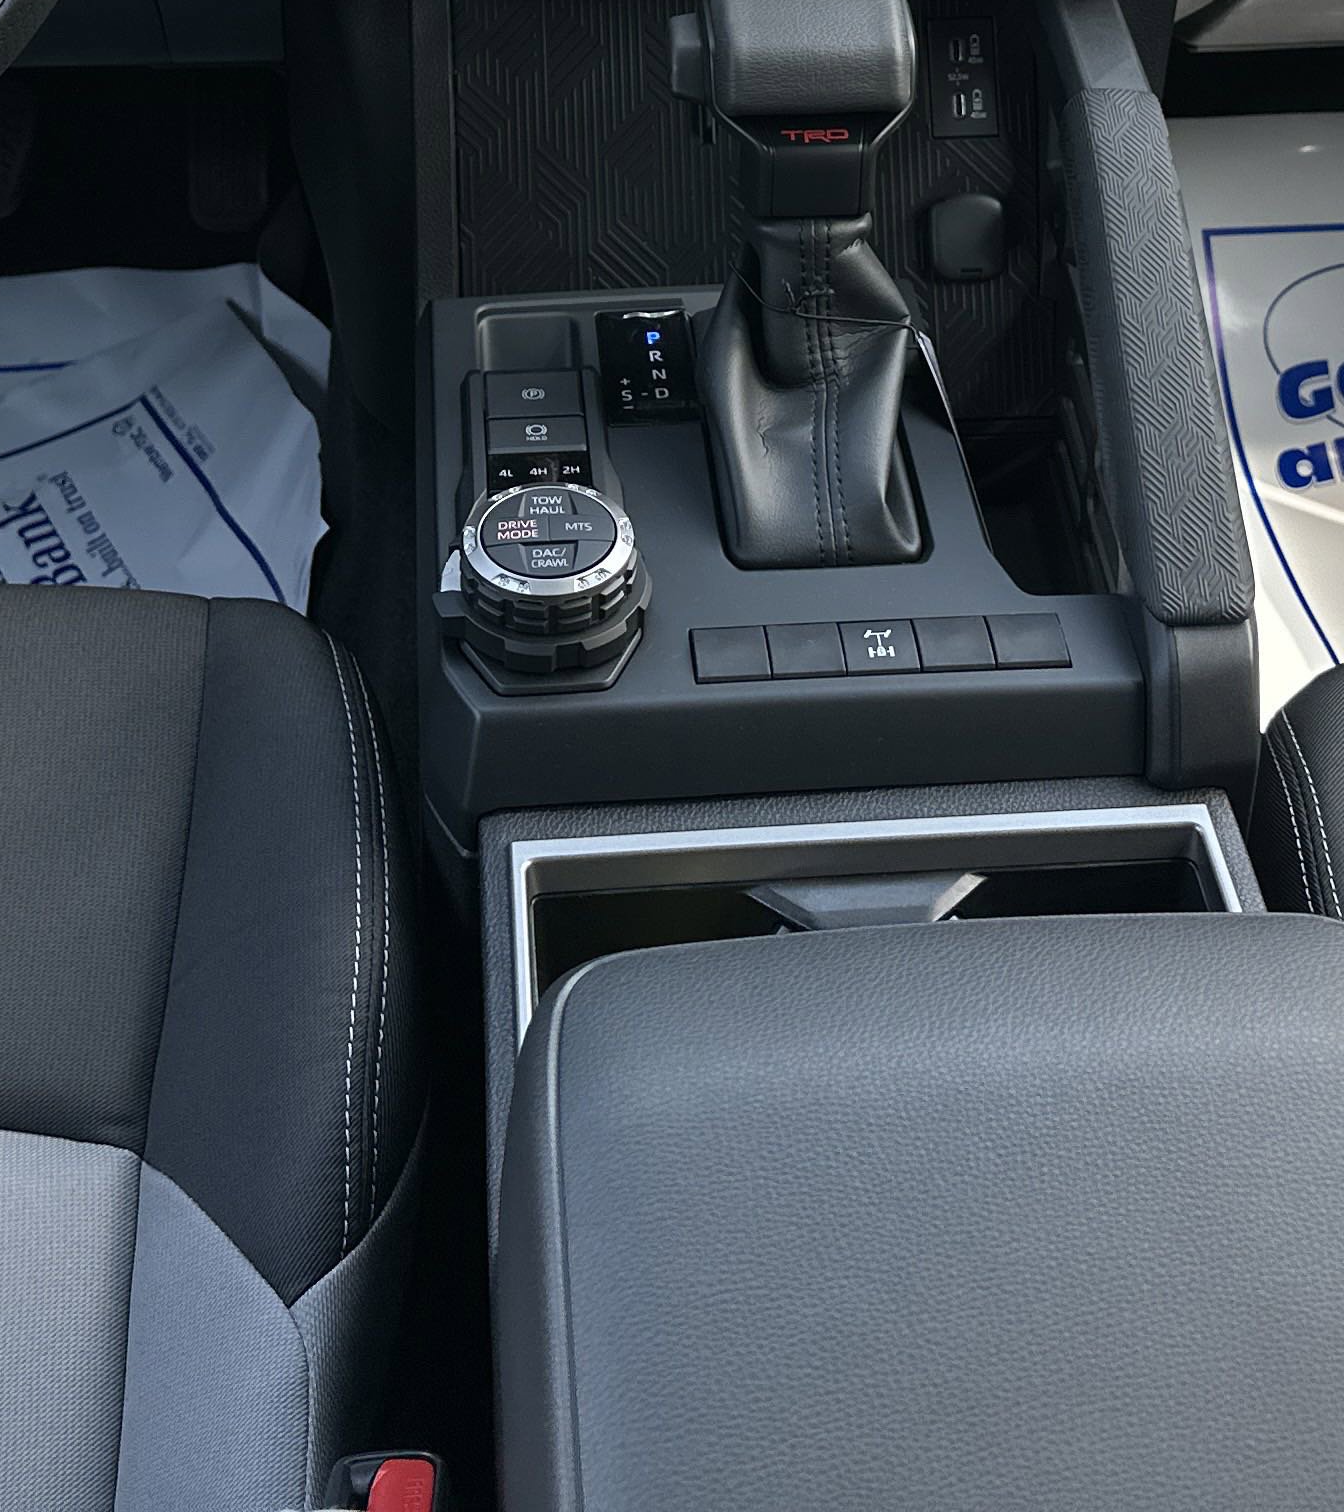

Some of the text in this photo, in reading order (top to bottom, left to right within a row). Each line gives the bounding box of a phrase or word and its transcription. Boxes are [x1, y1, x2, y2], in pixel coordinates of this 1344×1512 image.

[781, 129, 849, 143] TRD
[646, 331, 660, 345] P
[649, 350, 663, 363] R
[652, 368, 667, 381] N
[621, 387, 669, 402] S D
[498, 465, 581, 478] 4L 4H 2H
[531, 495, 563, 505] TOW
[529, 506, 566, 515] HAUL
[497, 519, 538, 531] DRIVE
[565, 522, 593, 531] MTS
[497, 528, 539, 540] MODE
[532, 547, 567, 558] DAC/
[531, 558, 569, 569] CRAWL
